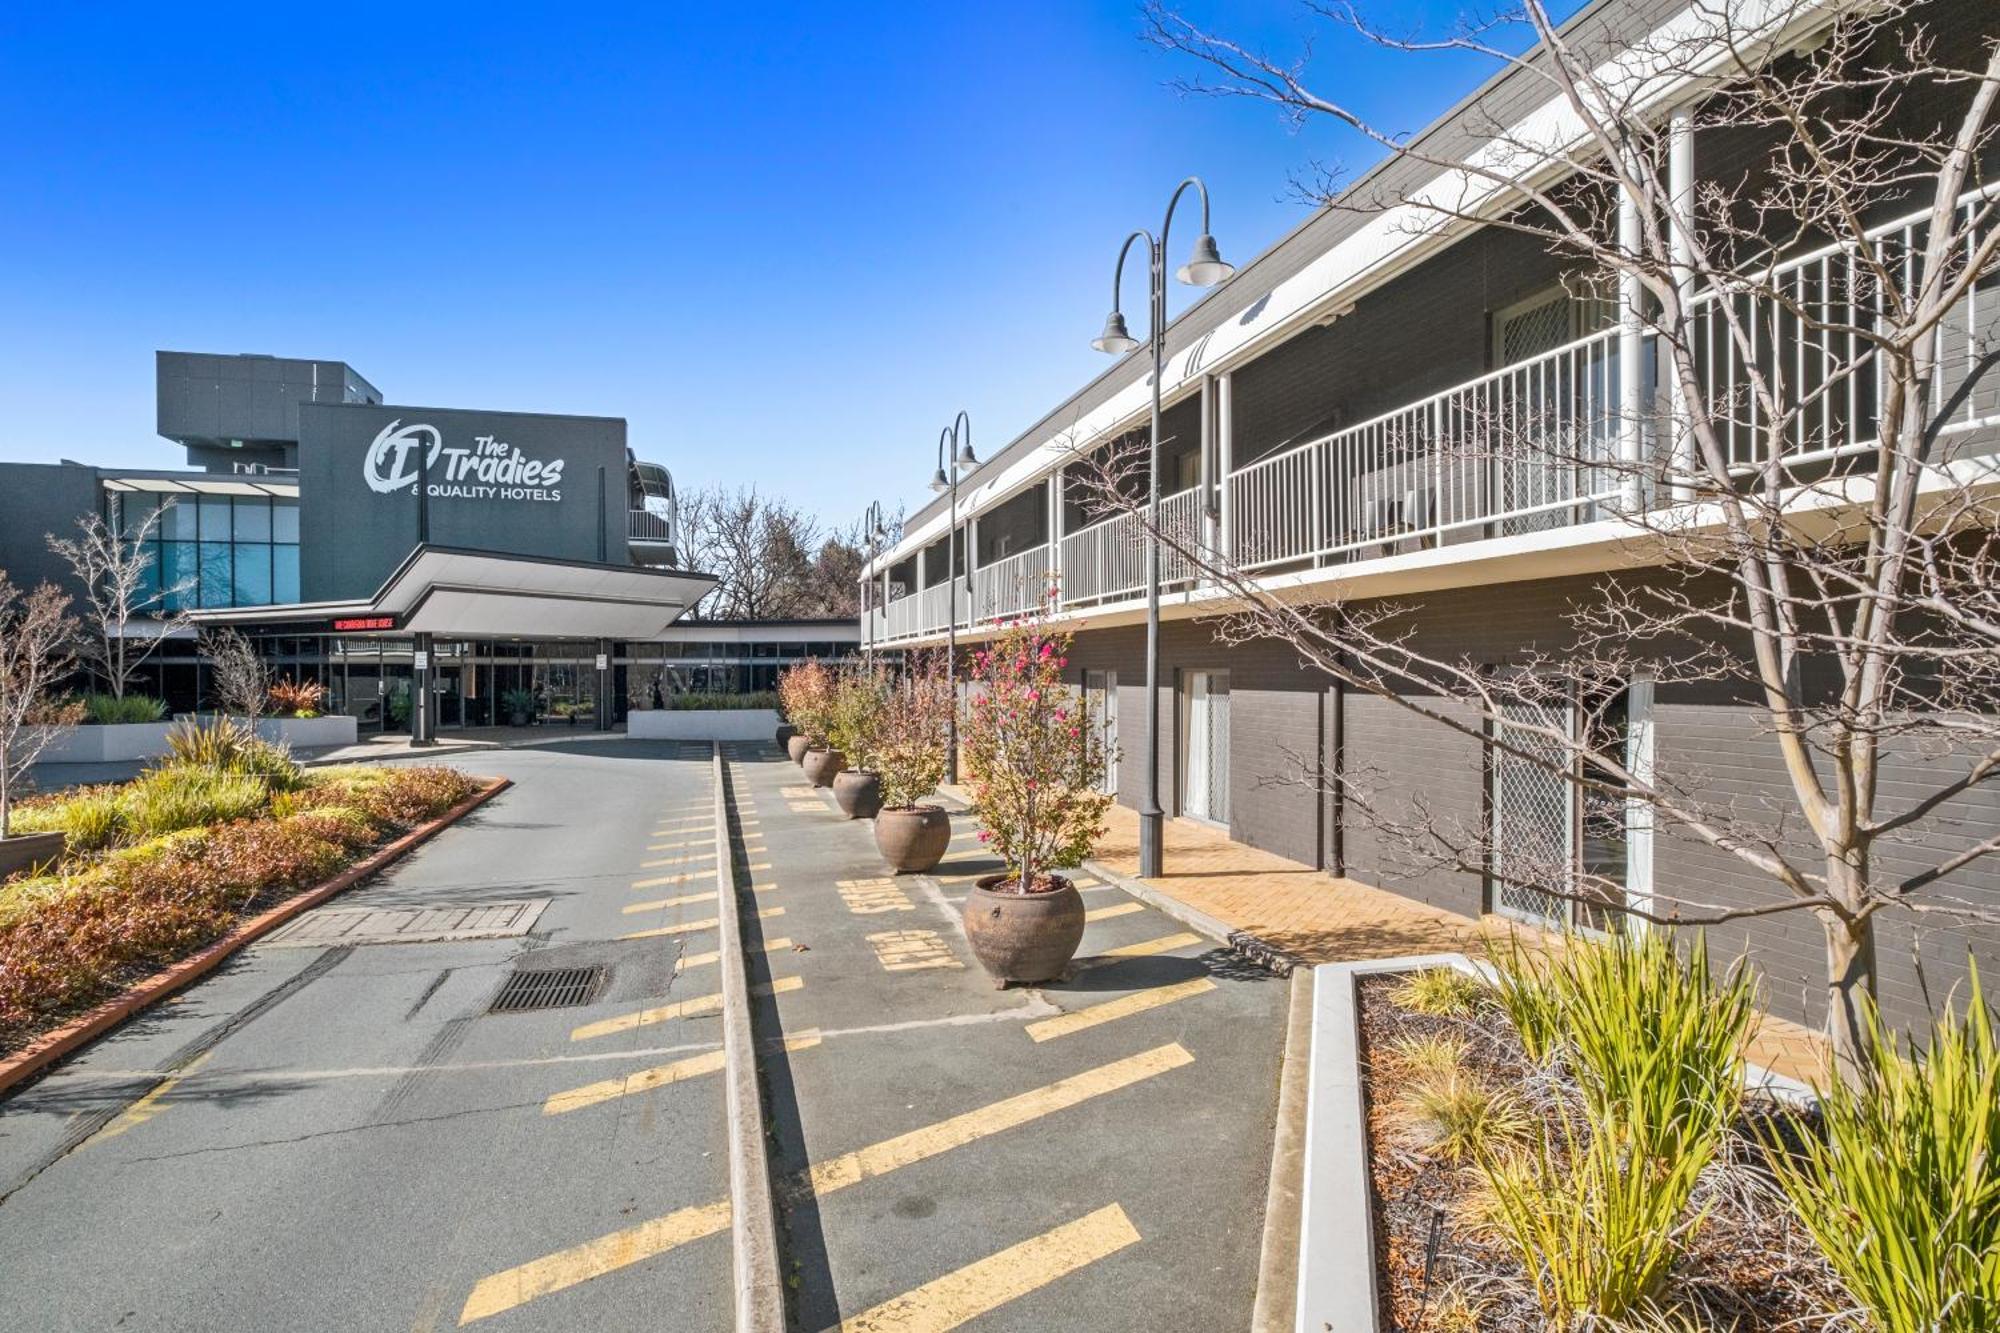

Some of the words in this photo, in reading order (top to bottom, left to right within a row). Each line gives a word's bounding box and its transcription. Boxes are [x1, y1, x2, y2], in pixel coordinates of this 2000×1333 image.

[475, 435, 509, 457] The
[441, 448, 565, 486] Tradies
[428, 485, 497, 499] QUALITY
[501, 488, 561, 501] HOTELS
